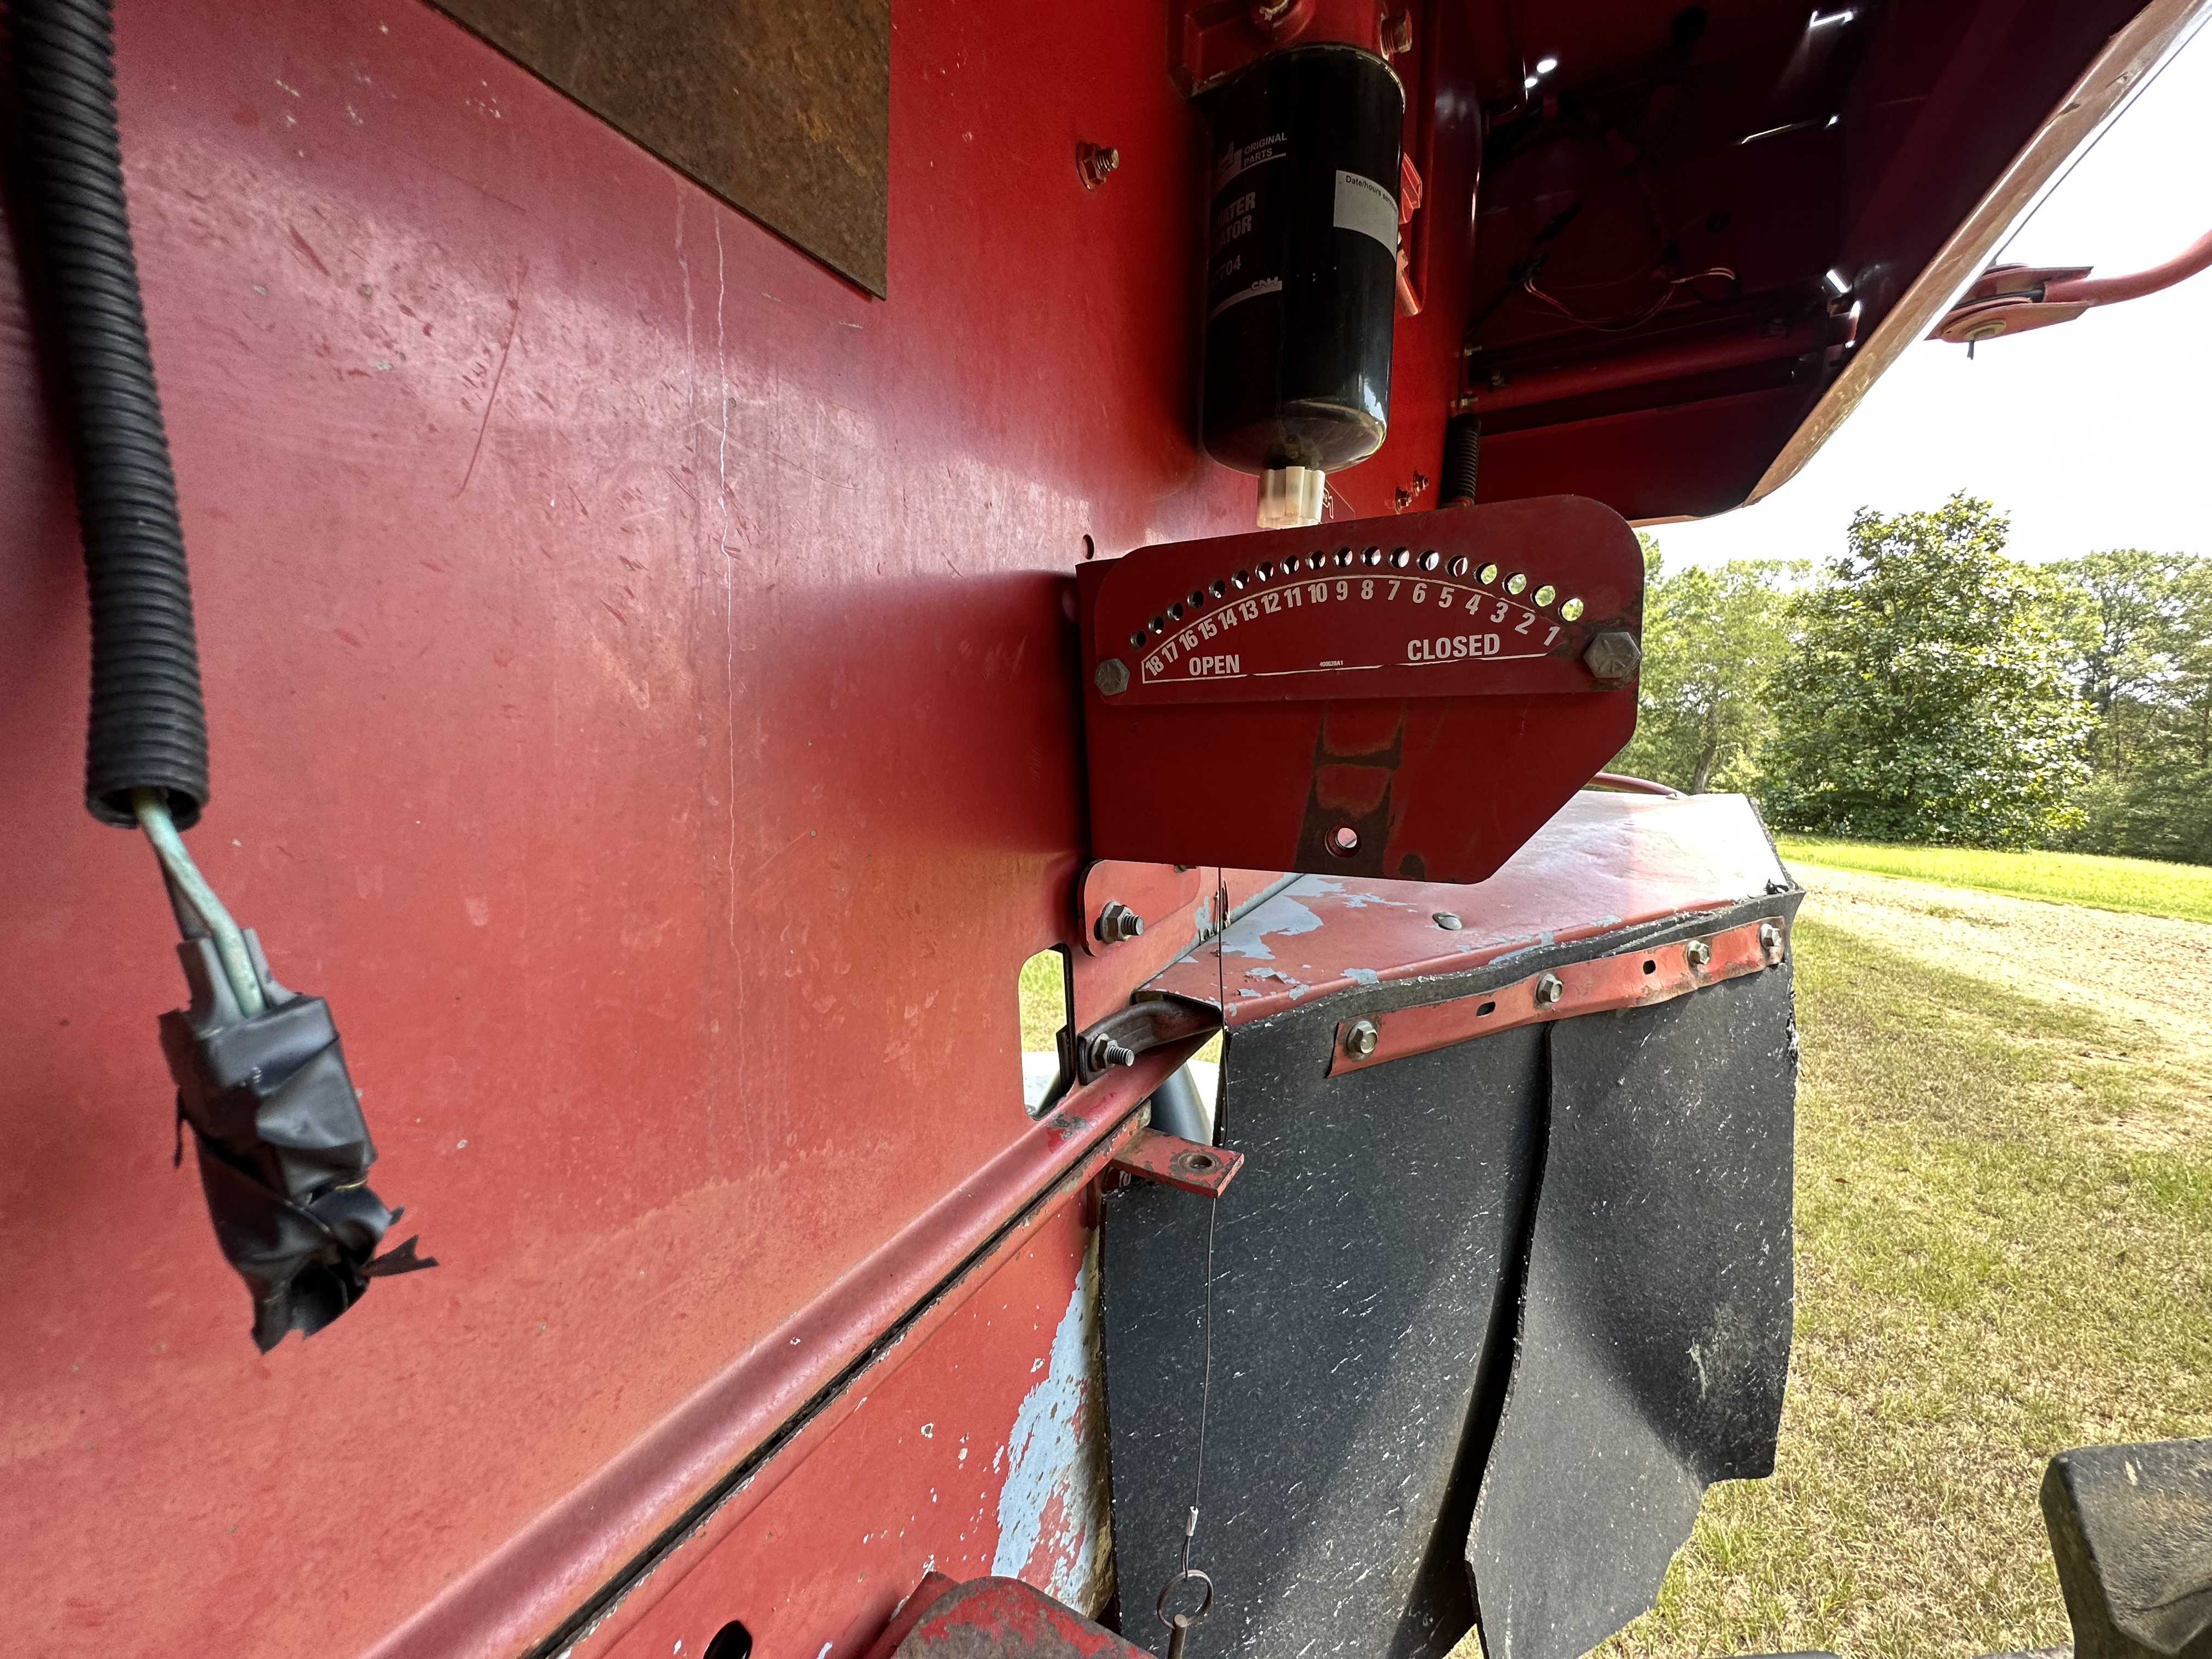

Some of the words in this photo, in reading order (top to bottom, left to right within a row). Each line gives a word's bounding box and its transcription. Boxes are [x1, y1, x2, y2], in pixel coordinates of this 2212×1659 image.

[1244, 132, 1287, 155] ORIGINAL
[1244, 148, 1272, 167] PARTS
[1346, 175, 1381, 196] Date/hours
[1146, 656, 1164, 676] 18
[1162, 641, 1178, 663] 17
[1179, 629, 1198, 651] 16
[1198, 618, 1217, 640] 15
[1218, 608, 1237, 630] 14
[1239, 600, 1258, 620] 13
[1261, 593, 1281, 613] 12
[1284, 588, 1301, 607] 11
[1308, 583, 1327, 603] 10
[1336, 581, 1347, 600] 9
[1361, 580, 1373, 599] 8
[1388, 580, 1400, 600] 7
[1413, 583, 1426, 603] 6
[1439, 587, 1454, 607] 5
[1465, 594, 1481, 614] 4
[1491, 602, 1508, 623] 3
[1515, 613, 1535, 634] 2
[1544, 627, 1560, 646] 1
[1408, 634, 1499, 660] CLOSED
[1189, 654, 1239, 675] OPEN
